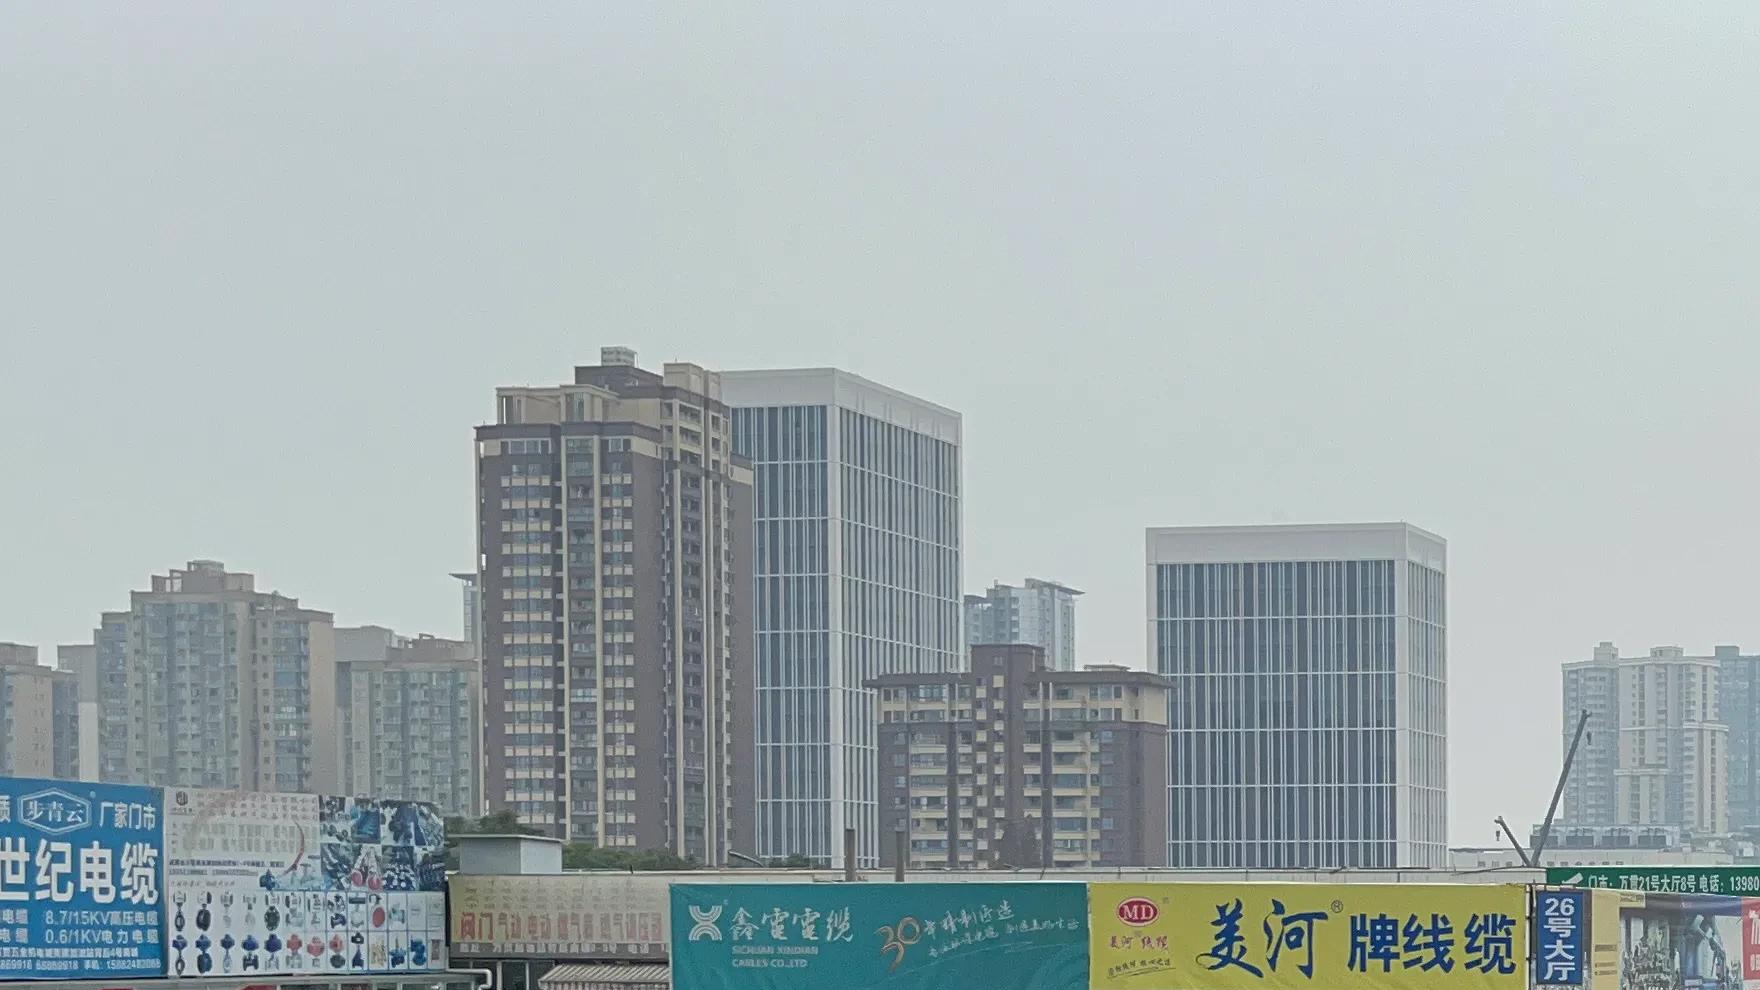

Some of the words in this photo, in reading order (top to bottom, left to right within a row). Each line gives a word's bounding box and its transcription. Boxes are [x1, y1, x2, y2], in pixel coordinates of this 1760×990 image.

[100, 801, 156, 831] 厂家门市
[0, 837, 158, 906] 世纪电缆
[1122, 904, 1155, 920] MD
[1195, 898, 1329, 979] 美河
[1347, 913, 1517, 974] 牌线缆
[1543, 897, 1577, 982] 26号大厅
